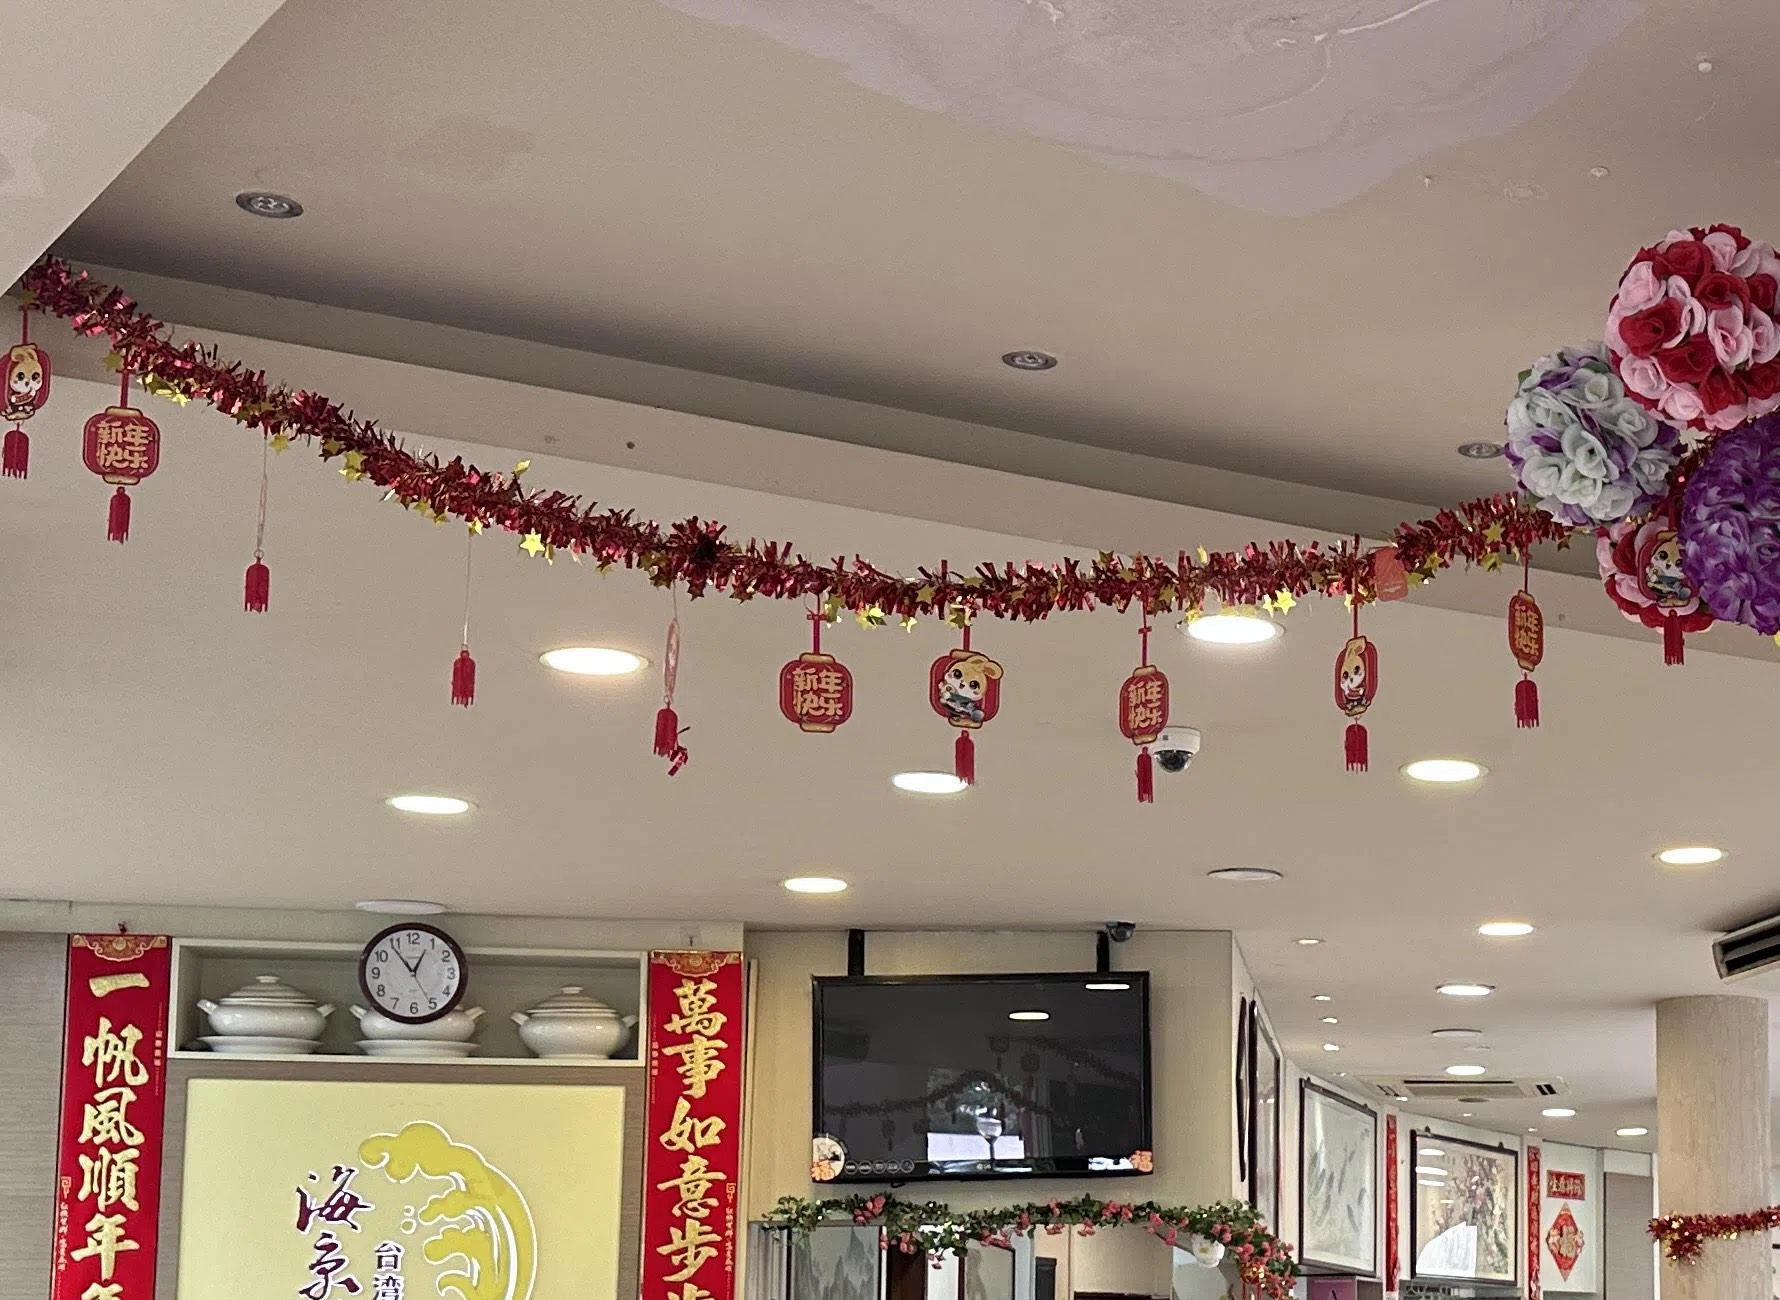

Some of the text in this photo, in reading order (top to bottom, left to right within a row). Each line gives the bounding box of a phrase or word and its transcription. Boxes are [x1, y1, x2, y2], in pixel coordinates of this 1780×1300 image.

[97, 420, 150, 445] 新年
[96, 444, 148, 471] 快乐
[792, 668, 844, 691] 新年
[1128, 680, 1162, 704] 新年
[792, 691, 843, 716] 快乐
[1128, 702, 1162, 729] 快乐
[406, 932, 421, 945] 12
[430, 938, 435, 949] 1
[375, 950, 389, 962] 10
[442, 950, 451, 962] 2
[371, 967, 380, 979] 9
[447, 968, 456, 980] 3
[376, 984, 385, 997] 8
[442, 985, 450, 997] 4
[391, 997, 399, 1009] 7
[410, 1002, 419, 1014] 6
[428, 998, 437, 1009] 5
